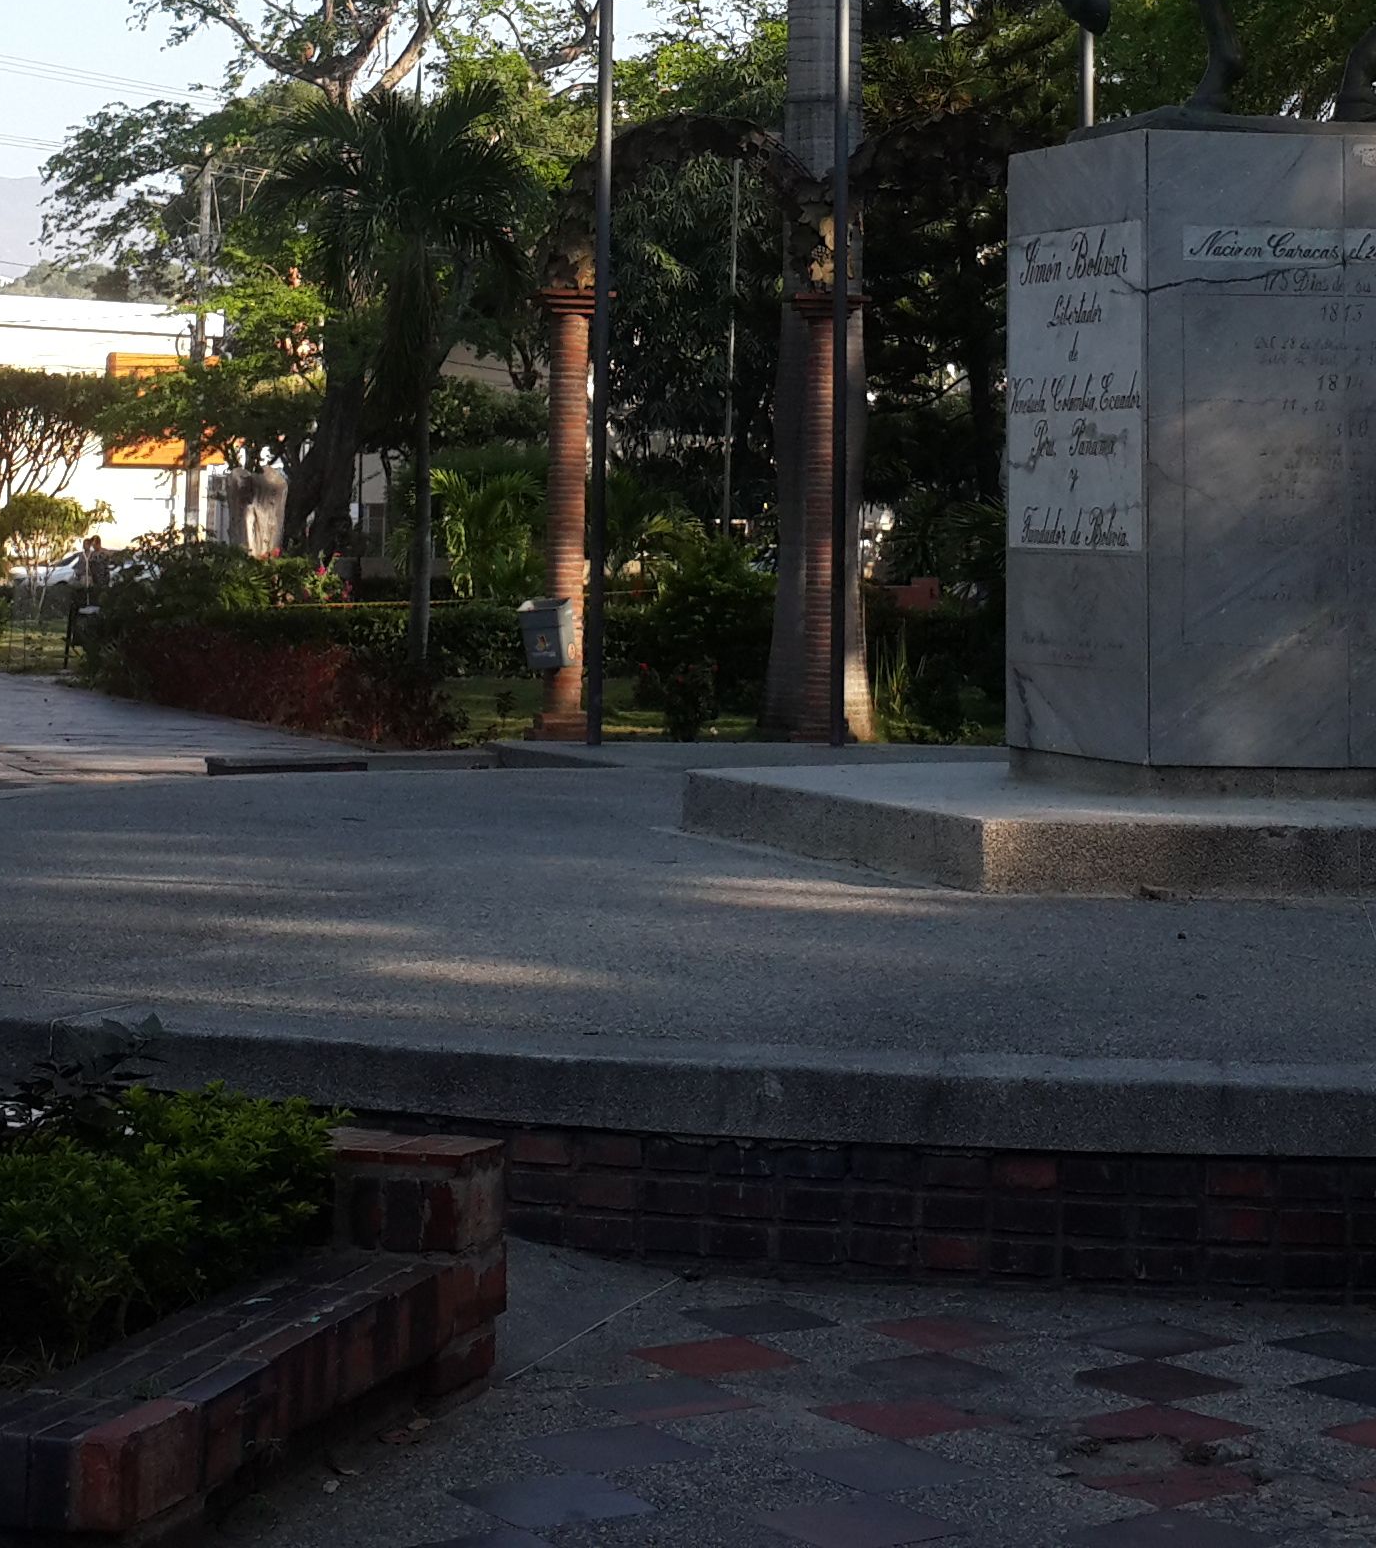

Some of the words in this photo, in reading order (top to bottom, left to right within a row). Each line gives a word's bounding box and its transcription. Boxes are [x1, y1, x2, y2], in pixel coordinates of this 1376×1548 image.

[1244, 246, 1263, 258] en
[1348, 233, 1371, 260] el
[1046, 291, 1102, 328] Libertador
[1067, 330, 1079, 362] de
[1068, 467, 1079, 492] y
[1070, 506, 1083, 545] de
